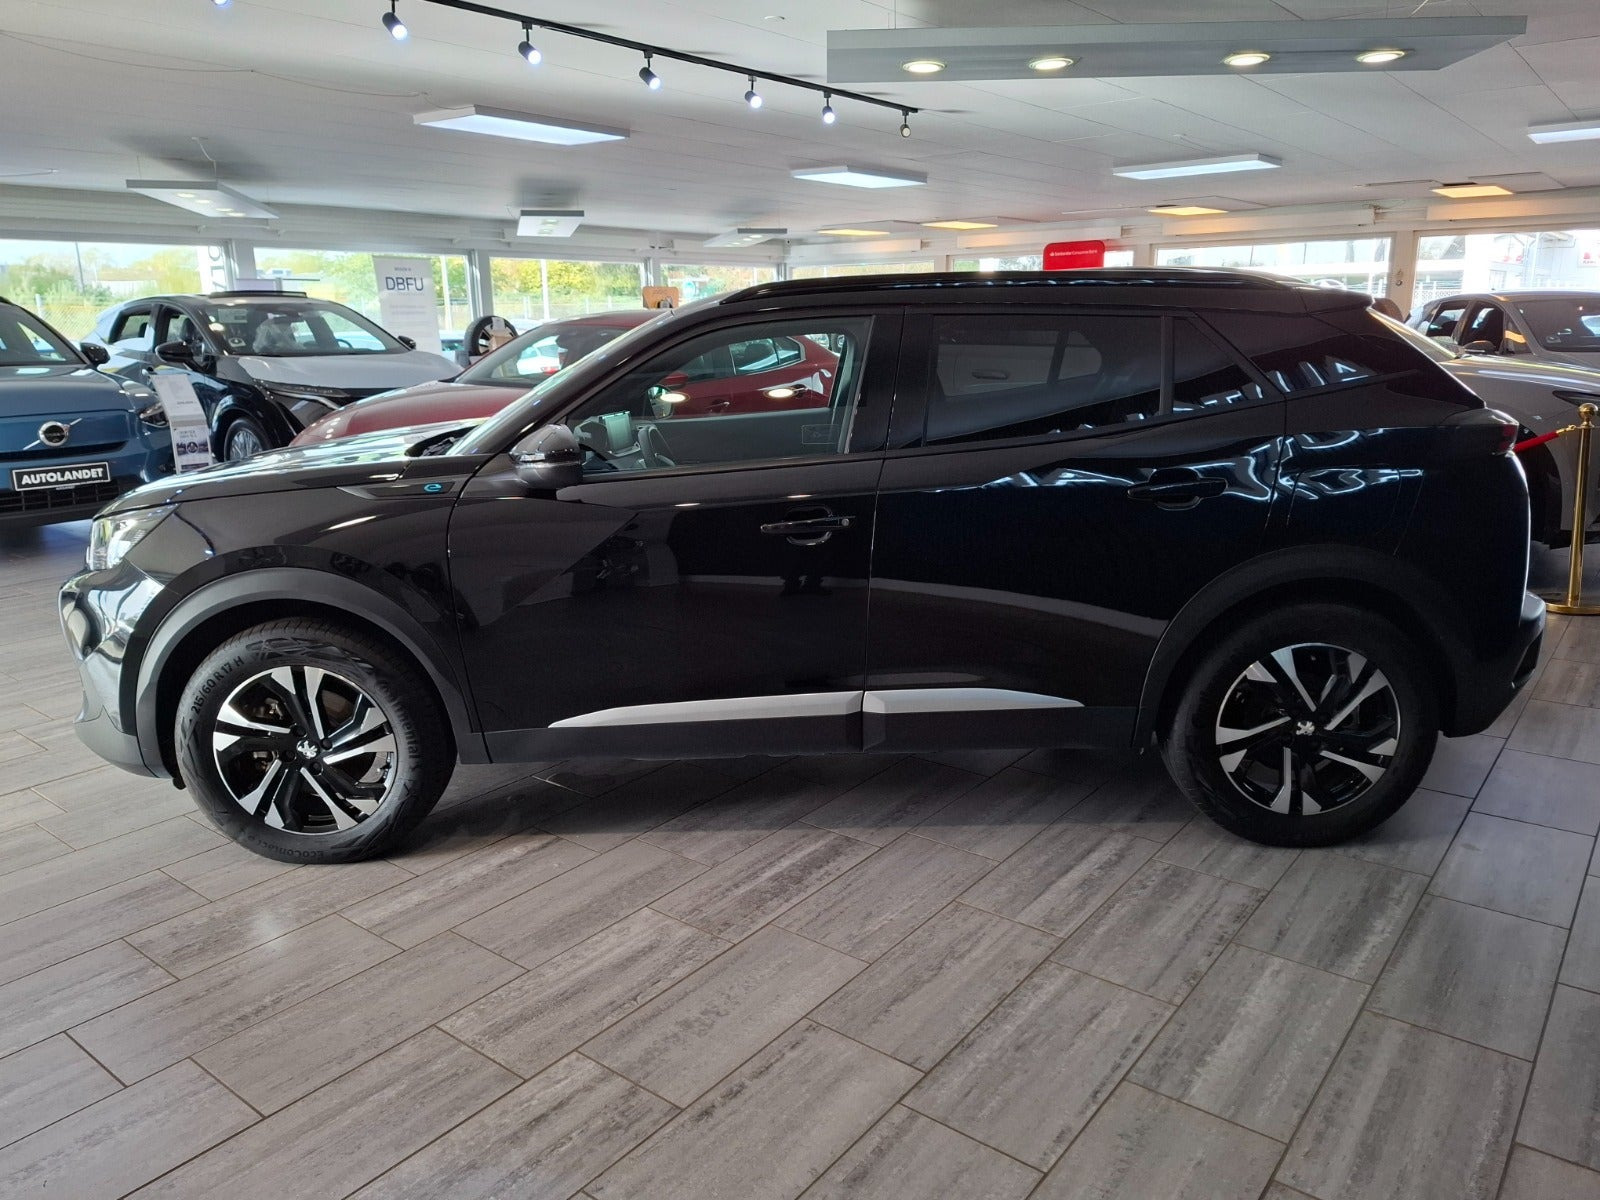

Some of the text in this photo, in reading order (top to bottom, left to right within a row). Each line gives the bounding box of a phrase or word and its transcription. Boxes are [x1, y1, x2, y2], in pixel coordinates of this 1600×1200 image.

[385, 276, 424, 292] DBFU
[21, 468, 104, 486] AUTOLANDET
[191, 655, 245, 714] 215/60 R 17 H
